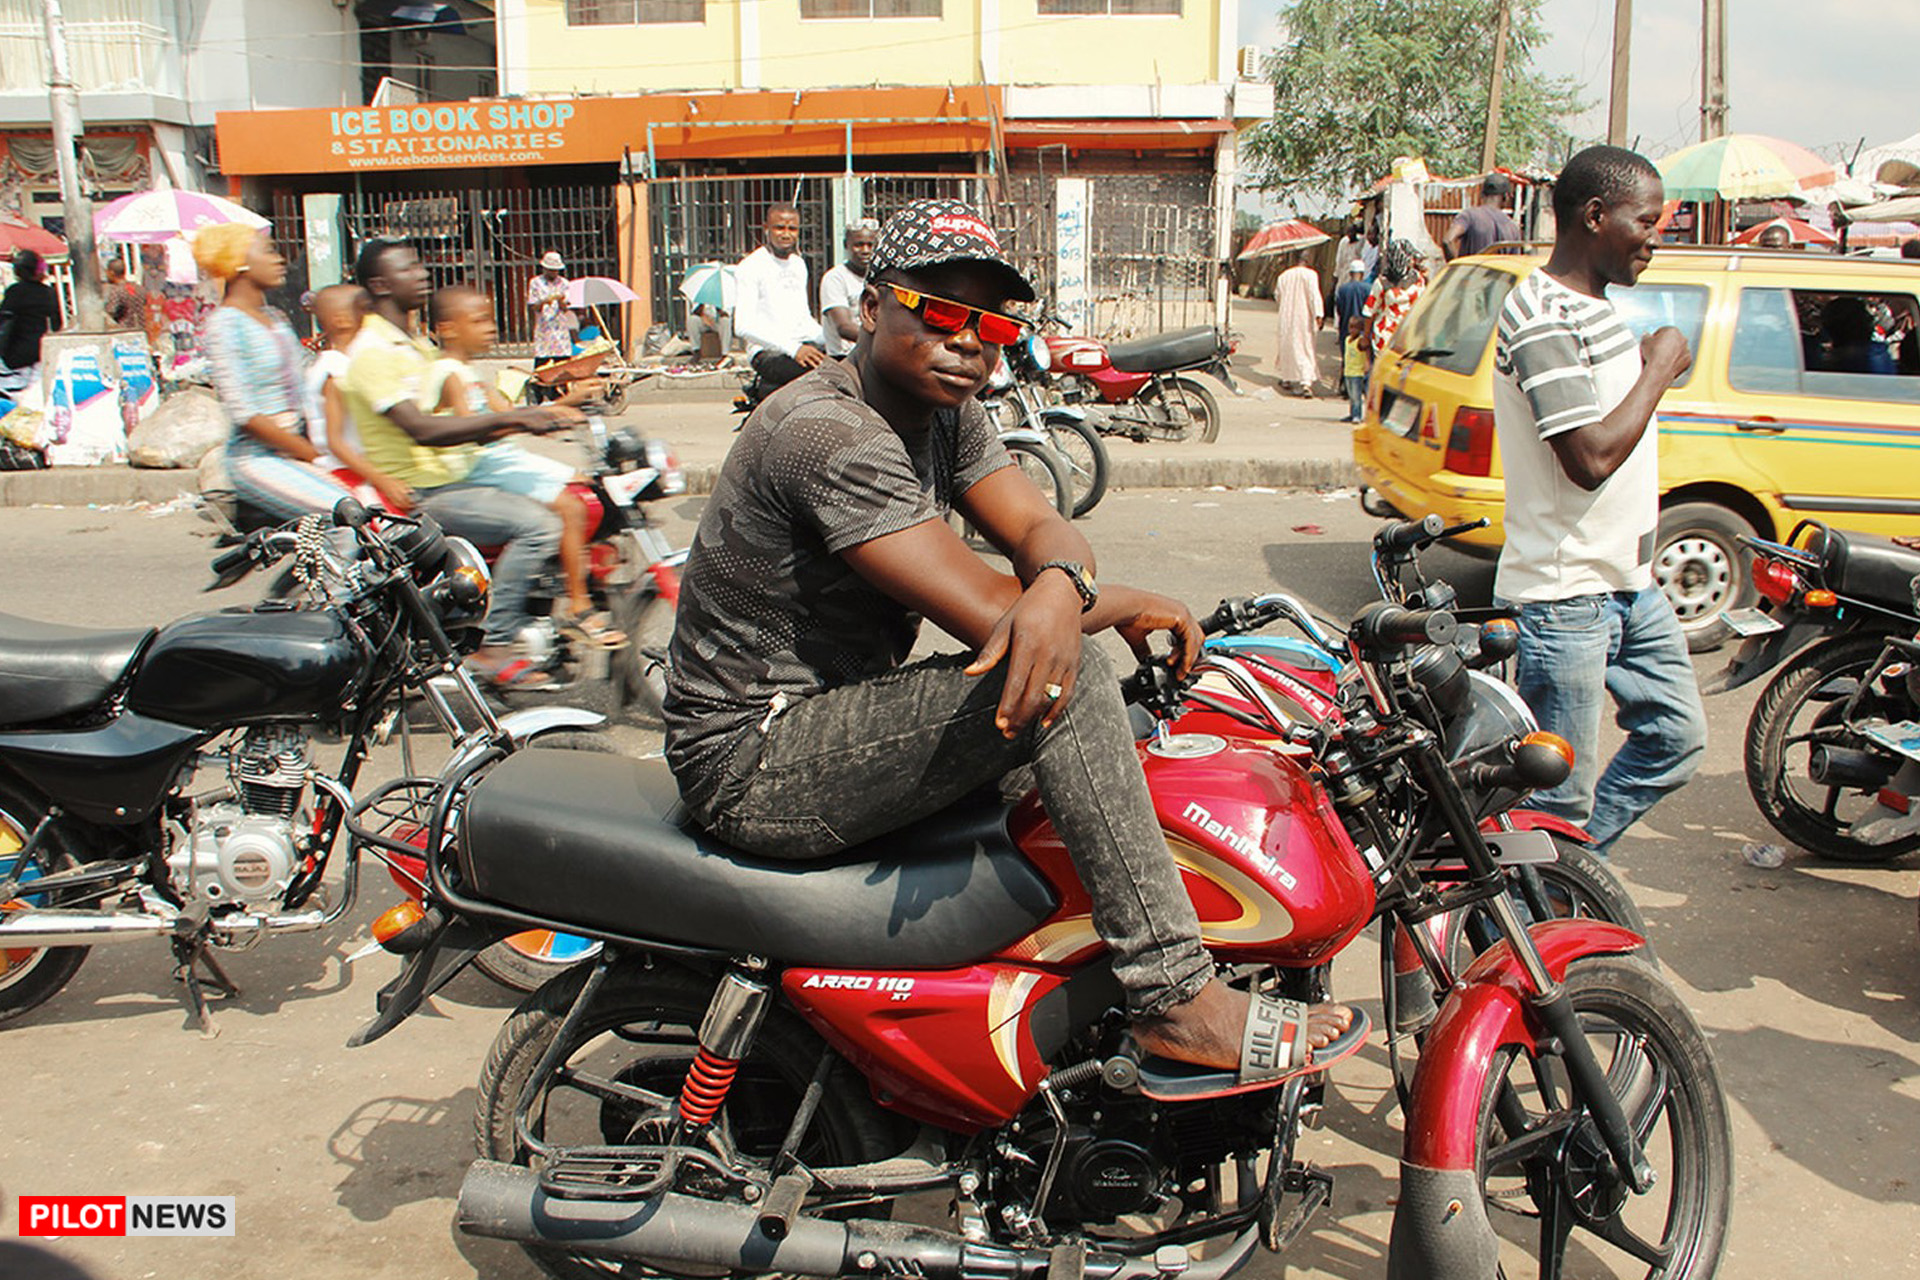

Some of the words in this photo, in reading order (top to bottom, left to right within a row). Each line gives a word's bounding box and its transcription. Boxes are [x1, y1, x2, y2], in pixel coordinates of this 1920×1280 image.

[330, 110, 382, 136] ICE
[389, 106, 480, 133] BOOK
[488, 103, 575, 129] SHOP
[331, 141, 345, 155] &
[348, 132, 565, 155] STATIONARIES
[1182, 801, 1298, 891] Mahindra
[1577, 858, 1620, 897] MRF
[802, 974, 874, 989] ARRO
[876, 976, 915, 992] 110
